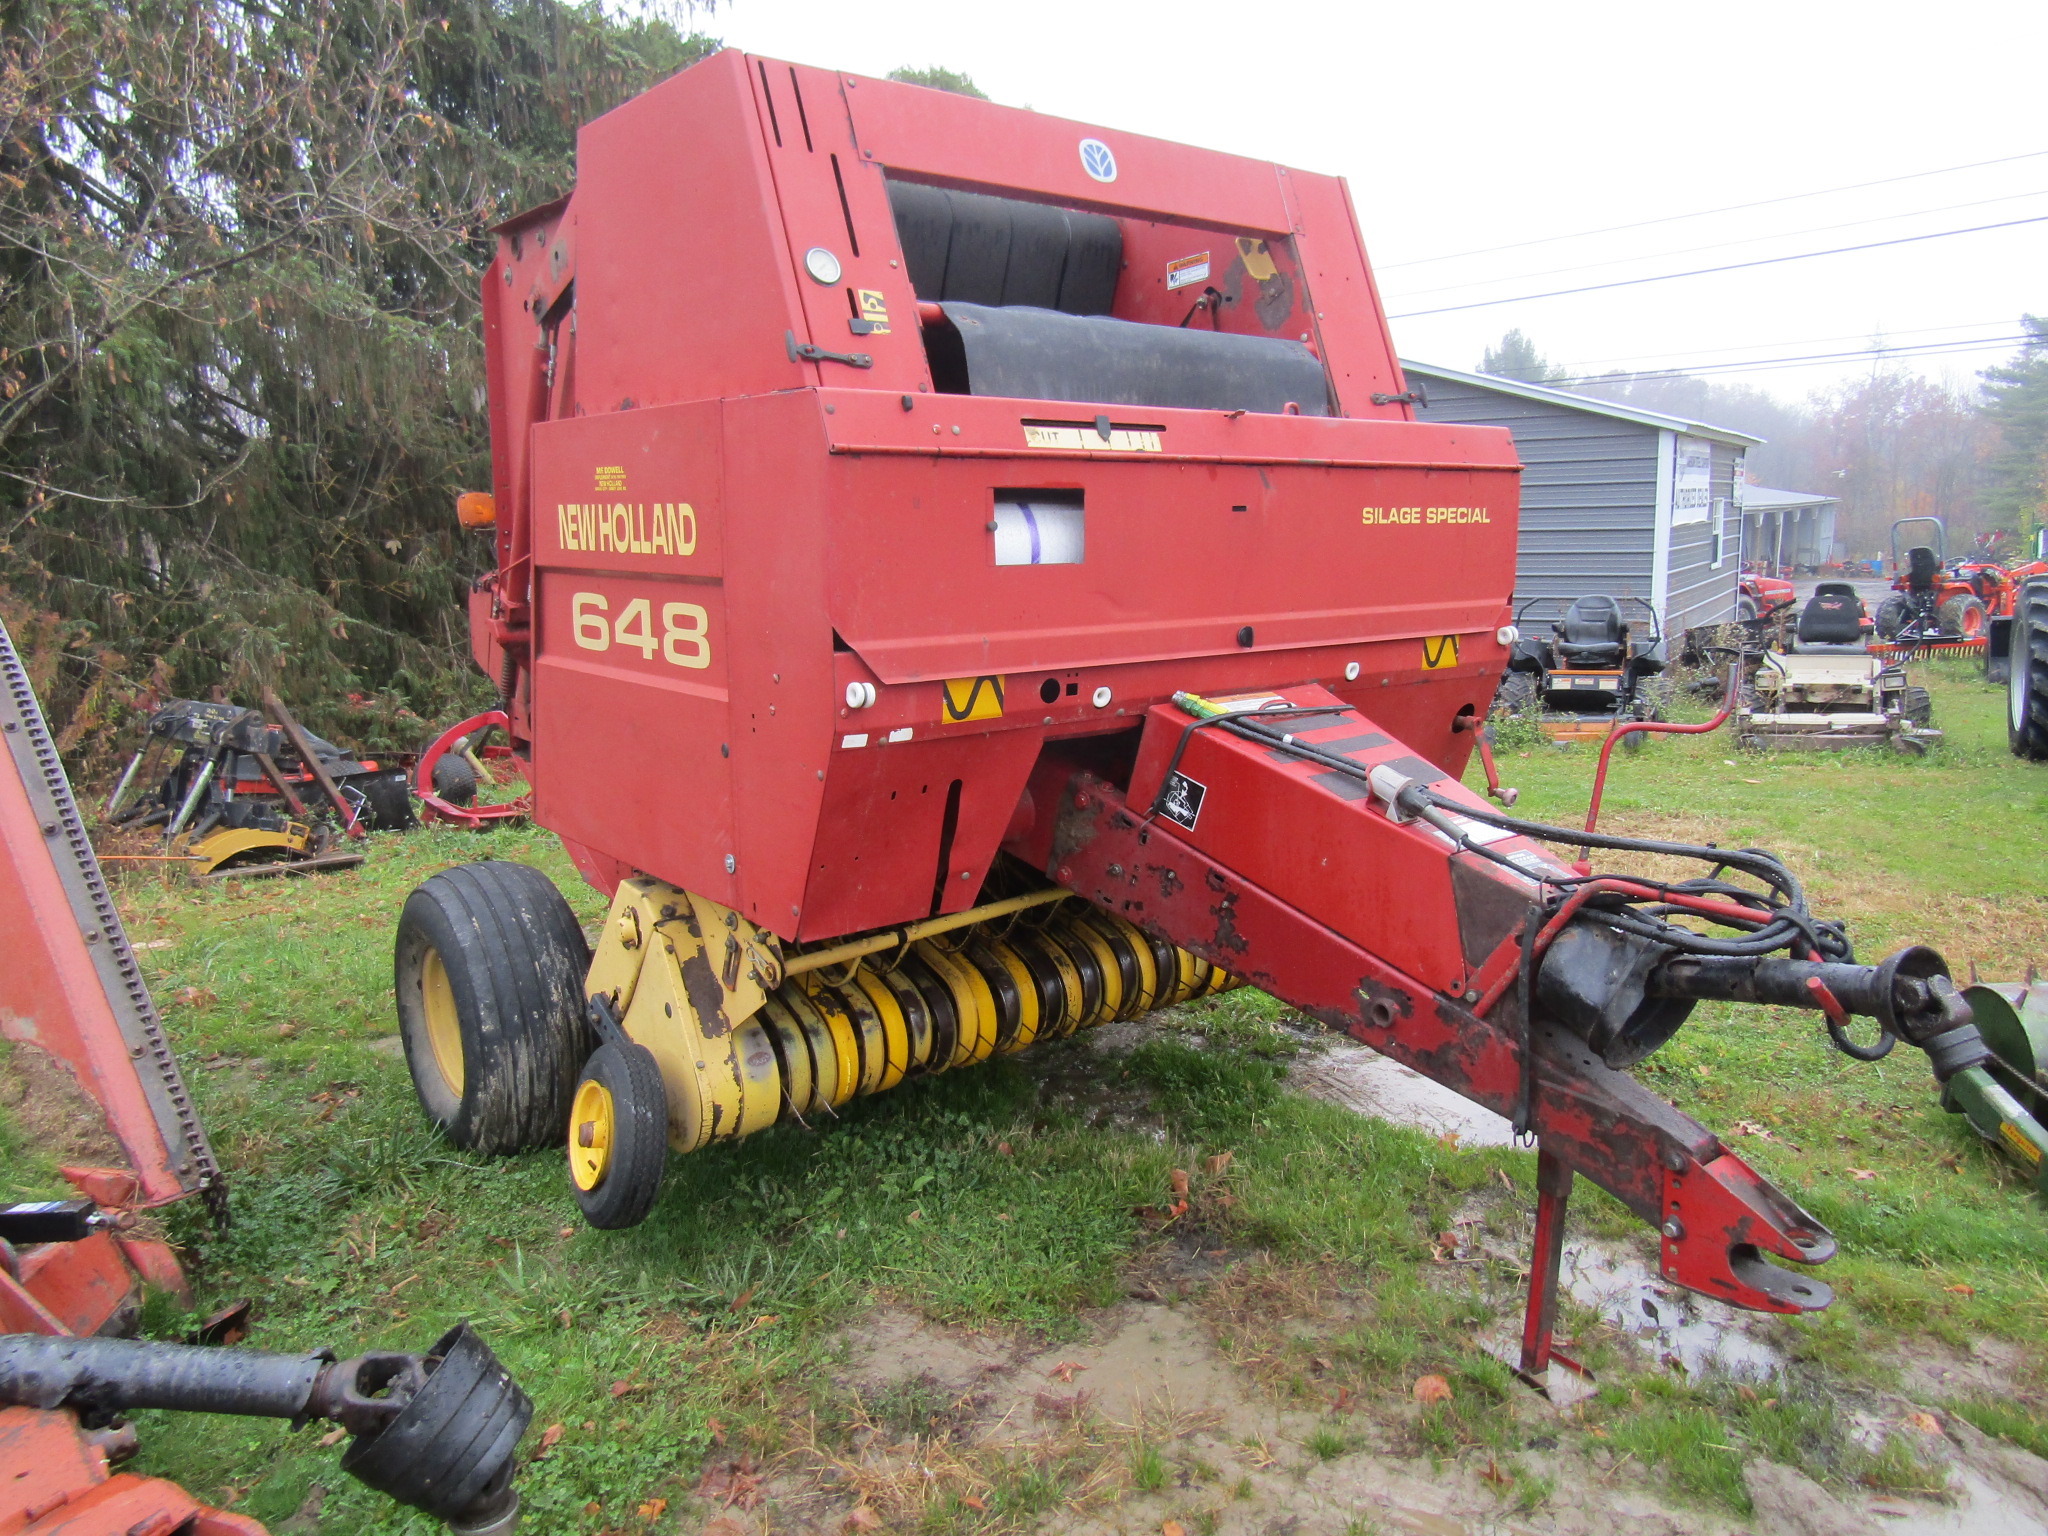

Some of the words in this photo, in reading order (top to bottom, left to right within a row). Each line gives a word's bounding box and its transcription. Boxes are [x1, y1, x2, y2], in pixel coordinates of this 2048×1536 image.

[558, 504, 596, 551] NEW
[599, 503, 697, 556] HOLLAND
[1362, 507, 1421, 524] SILAGE
[1426, 507, 1491, 524] SPECIAL
[572, 592, 711, 669] 648
